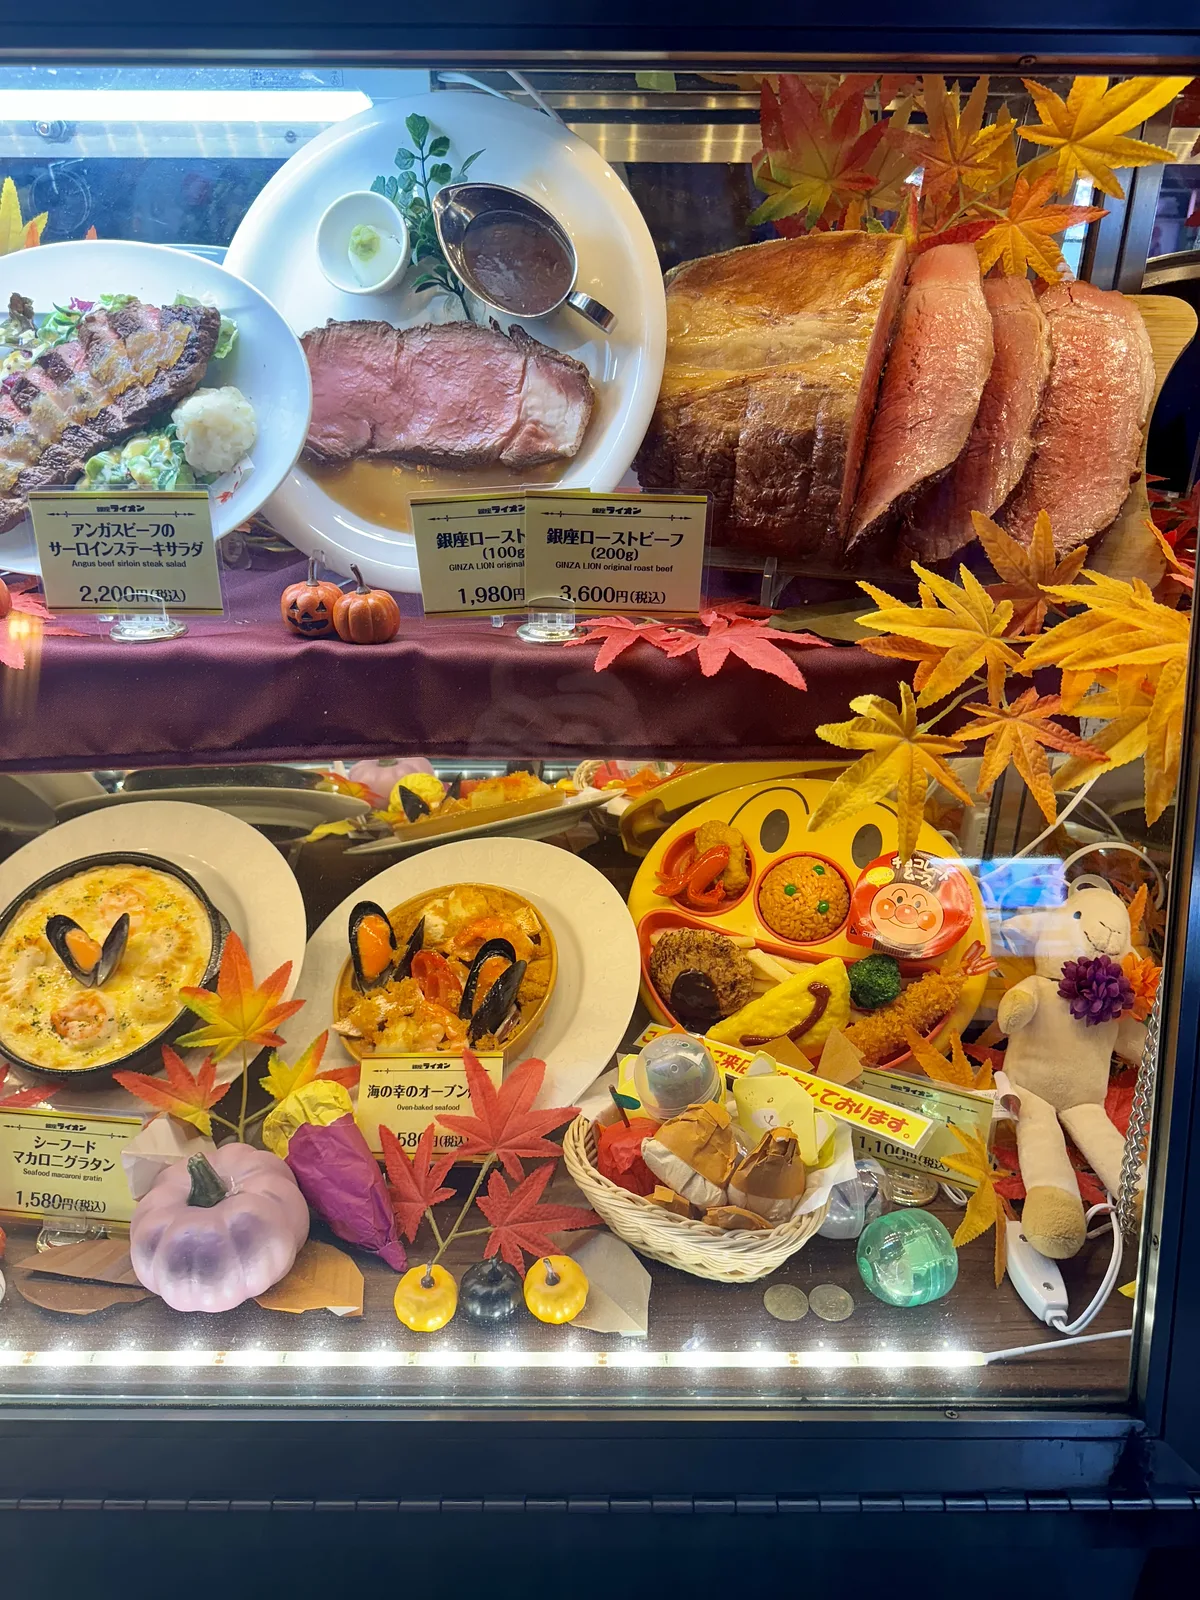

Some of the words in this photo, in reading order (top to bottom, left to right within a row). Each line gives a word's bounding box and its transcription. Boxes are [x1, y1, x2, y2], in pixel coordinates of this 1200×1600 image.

[71, 522, 175, 538] アンガスビーフの
[546, 527, 684, 548] 銀座ローストビーフ
[48, 541, 204, 557] サーロインステーキサラダ
[482, 546, 525, 560] (100g
[591, 547, 639, 561] (200g)
[71, 560, 96, 568] Angus
[165, 560, 187, 568] salad
[448, 563, 475, 572] GINZA
[476, 562, 495, 570] LION
[496, 560, 525, 570] original
[555, 562, 581, 570] GINZA
[582, 562, 601, 570] LION
[603, 562, 632, 572] original
[633, 564, 654, 572] roast
[655, 564, 673, 573] beef
[79, 585, 186, 604] 2,200円(税込)
[457, 585, 525, 606] 1,980円
[559, 585, 666, 605] 3,600円(税込)
[34, 1135, 97, 1154] シーフード
[12, 1150, 116, 1172] マカロニグラタン
[23, 1168, 50, 1177] Seafood
[51, 1171, 82, 1180] macaroni
[16, 1190, 107, 1214] 1,580円(税込)
